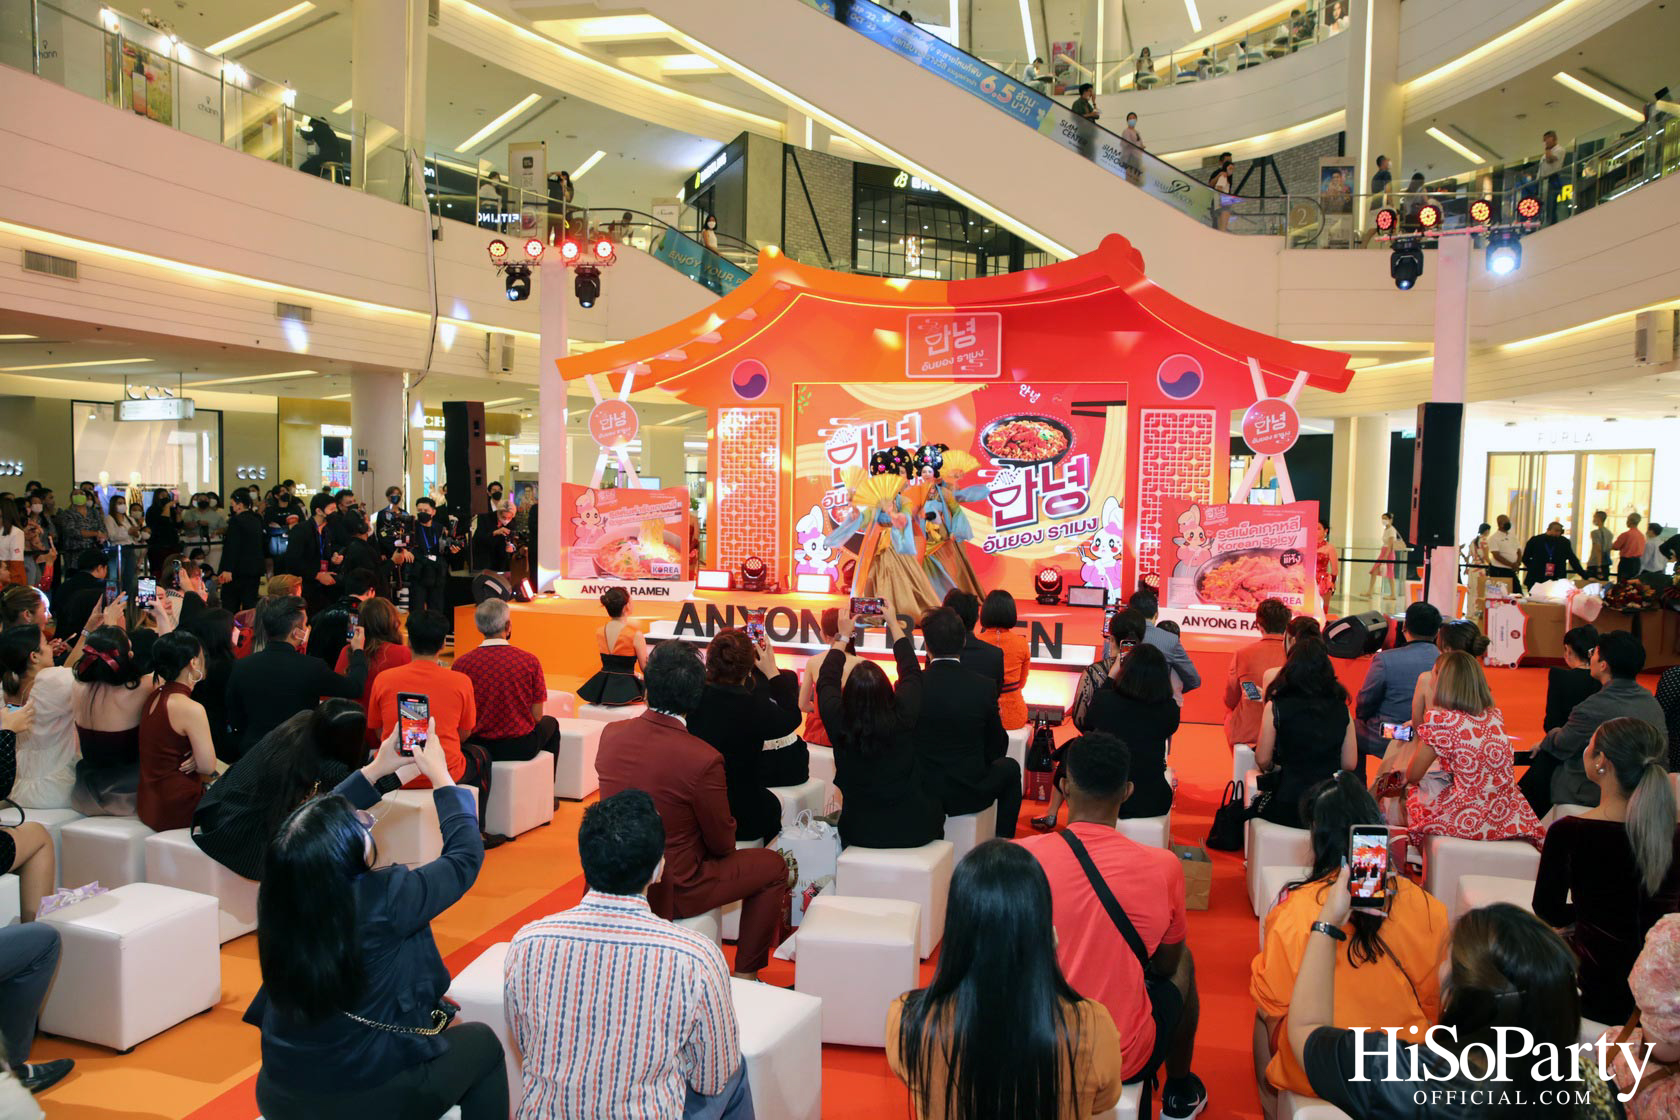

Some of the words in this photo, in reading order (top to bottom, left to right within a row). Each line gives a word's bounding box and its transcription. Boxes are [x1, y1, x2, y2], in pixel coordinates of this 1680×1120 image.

[979, 74, 1017, 103] 6.5
[1059, 119, 1078, 133] SIAM
[1062, 128, 1089, 147] CENTER
[1297, 208, 1307, 225] 2
[668, 250, 701, 268] ENJOY
[703, 264, 735, 281] YOUR
[1019, 383, 1041, 404] 안녕
[236, 465, 267, 480] COS
[985, 453, 1091, 532] 안녕
[981, 528, 1045, 554] อันยอง
[1047, 516, 1100, 539] ราเมง
[1216, 515, 1301, 541] รสเผ็ดเกาหลี
[1216, 540, 1259, 554] Korean
[1261, 534, 1298, 551] Spicy
[652, 566, 679, 574] KOREA
[580, 585, 627, 595] ANYO
[630, 587, 670, 596] RAMEN
[1181, 616, 1237, 629] ANYONG
